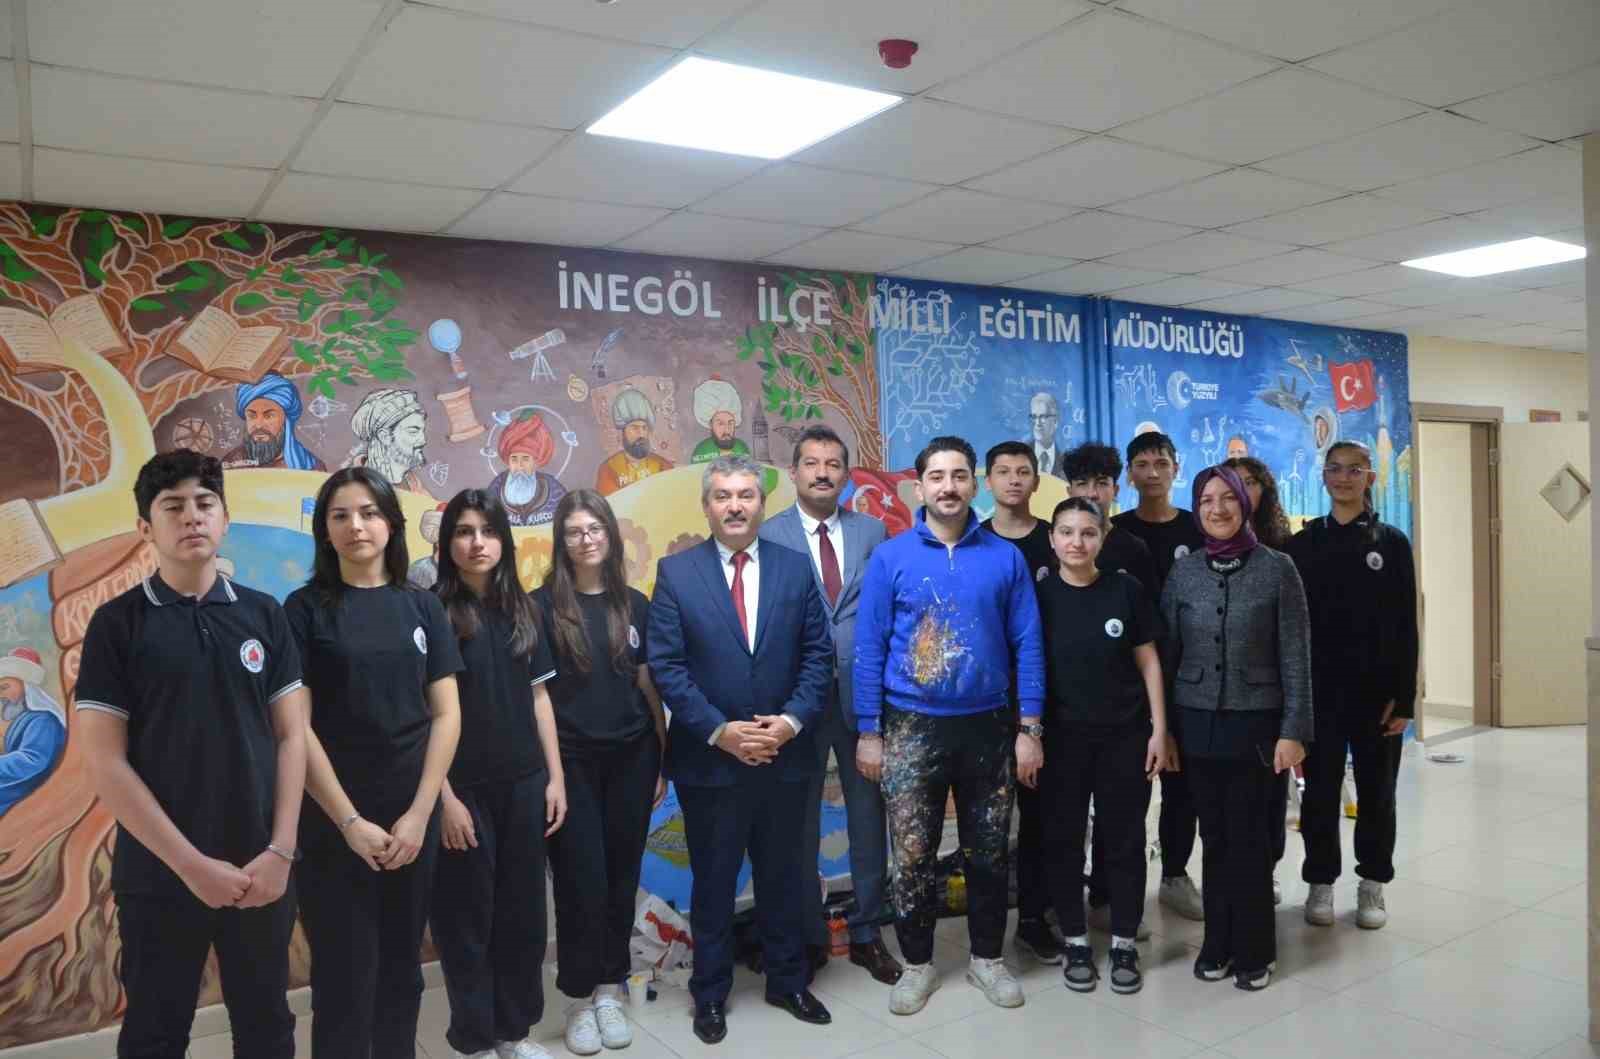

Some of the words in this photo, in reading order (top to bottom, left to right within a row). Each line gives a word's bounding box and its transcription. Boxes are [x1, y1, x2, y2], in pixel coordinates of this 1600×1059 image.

[558, 260, 722, 318] İNEGÖL
[757, 276, 833, 333] İLÇE
[979, 298, 1081, 344] EĞİTİM
[1103, 311, 1244, 359] MÜDÜRLÜĞÜ
